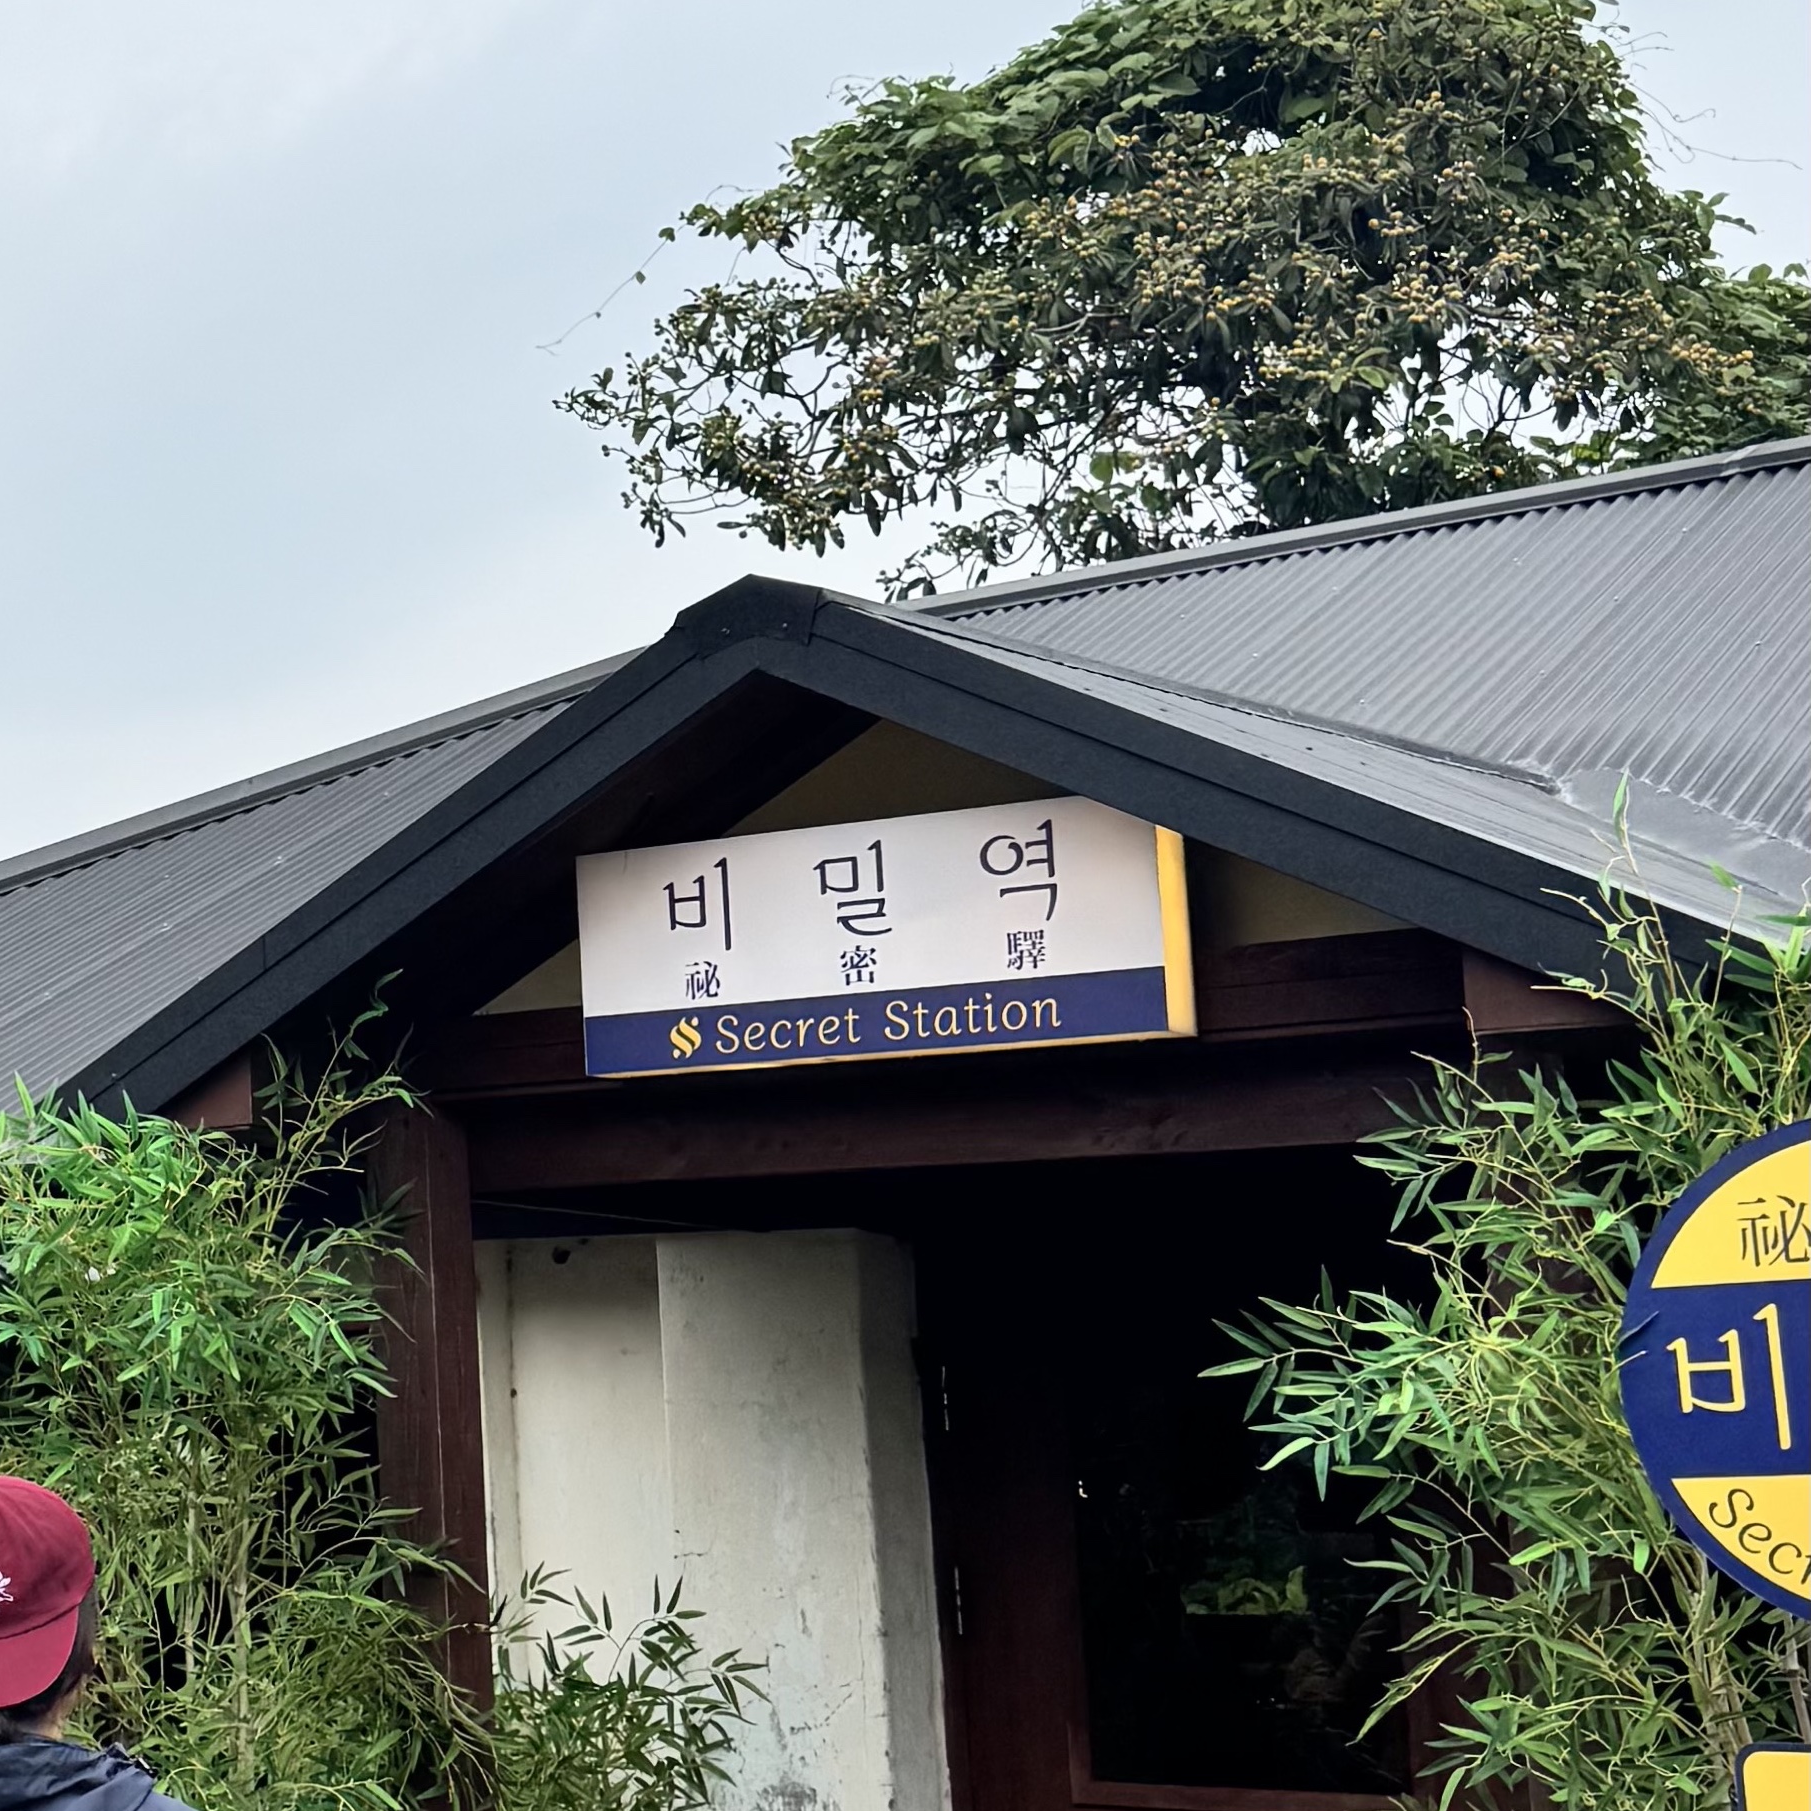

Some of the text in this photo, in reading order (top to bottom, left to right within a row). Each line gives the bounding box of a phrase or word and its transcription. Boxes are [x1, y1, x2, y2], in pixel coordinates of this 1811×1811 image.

[715, 992, 1062, 1054] Secret Station
[1666, 1303, 1792, 1451] 비
